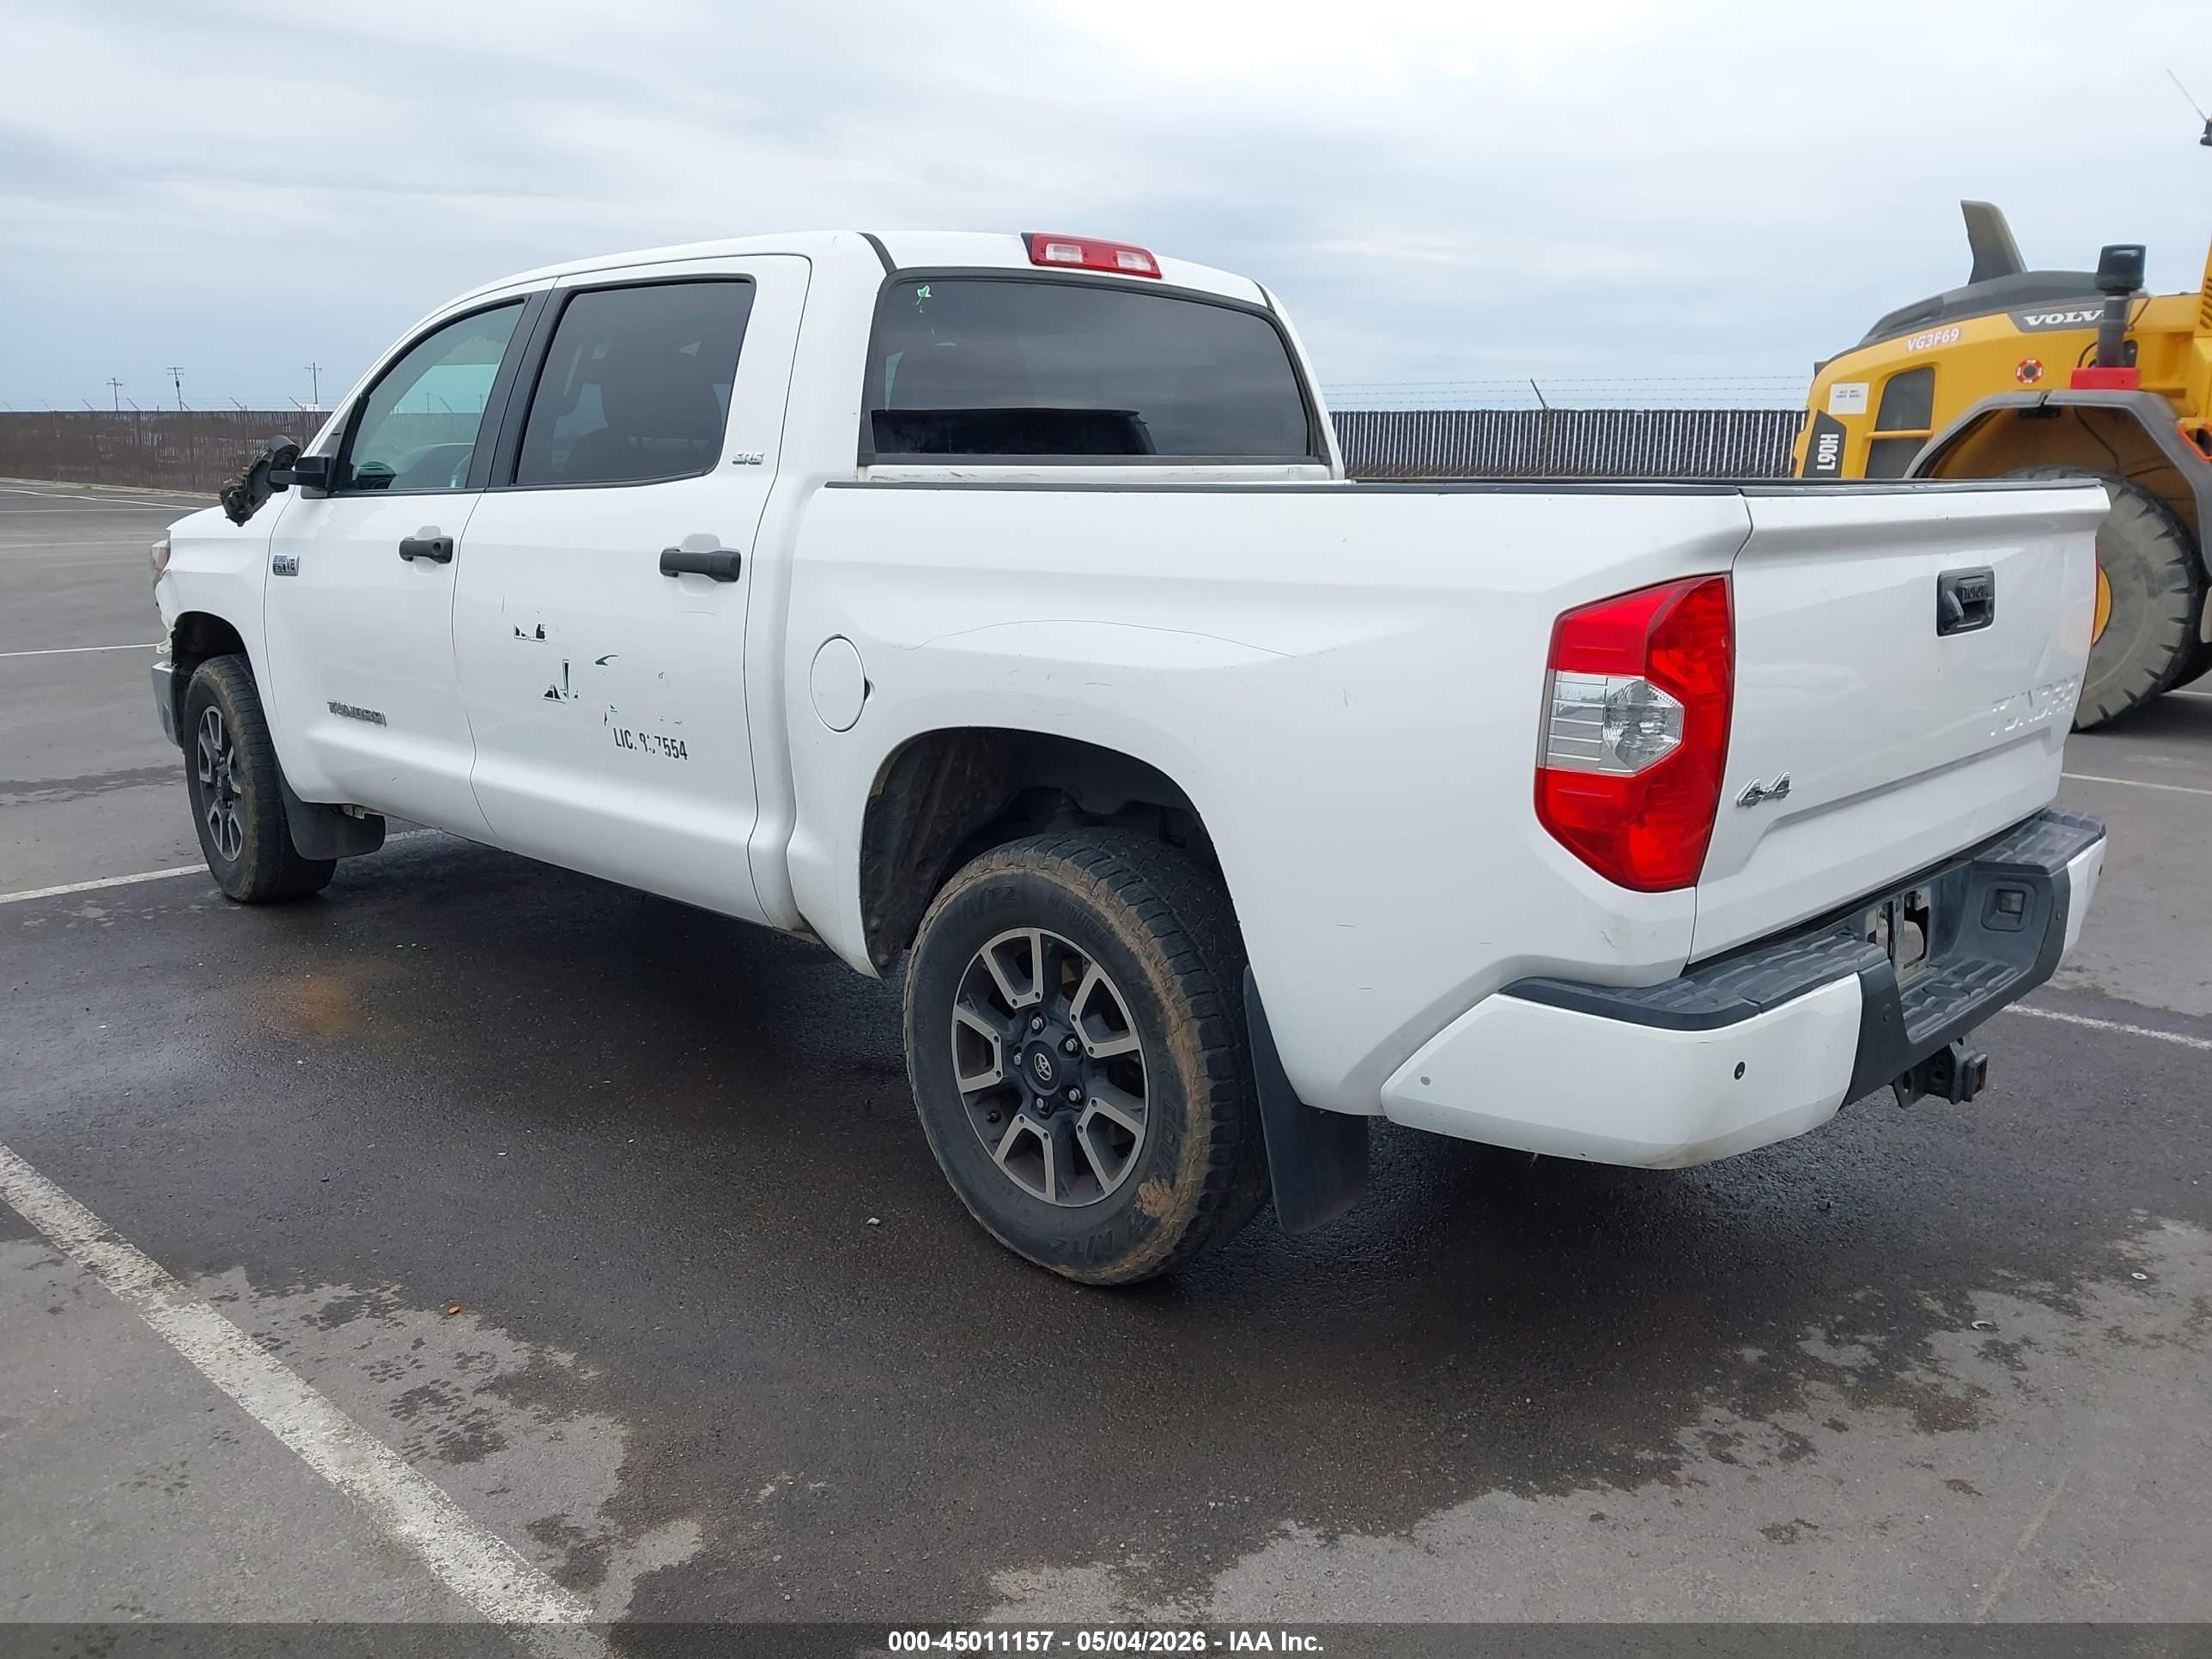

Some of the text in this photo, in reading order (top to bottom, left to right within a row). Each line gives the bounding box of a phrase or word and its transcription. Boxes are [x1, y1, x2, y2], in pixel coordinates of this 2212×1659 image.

[2023, 309, 2104, 327] VOLV
[1906, 327, 1960, 352] VG3F69
[1816, 433, 1839, 471] L90H
[613, 727, 688, 761] LIC. 97554
